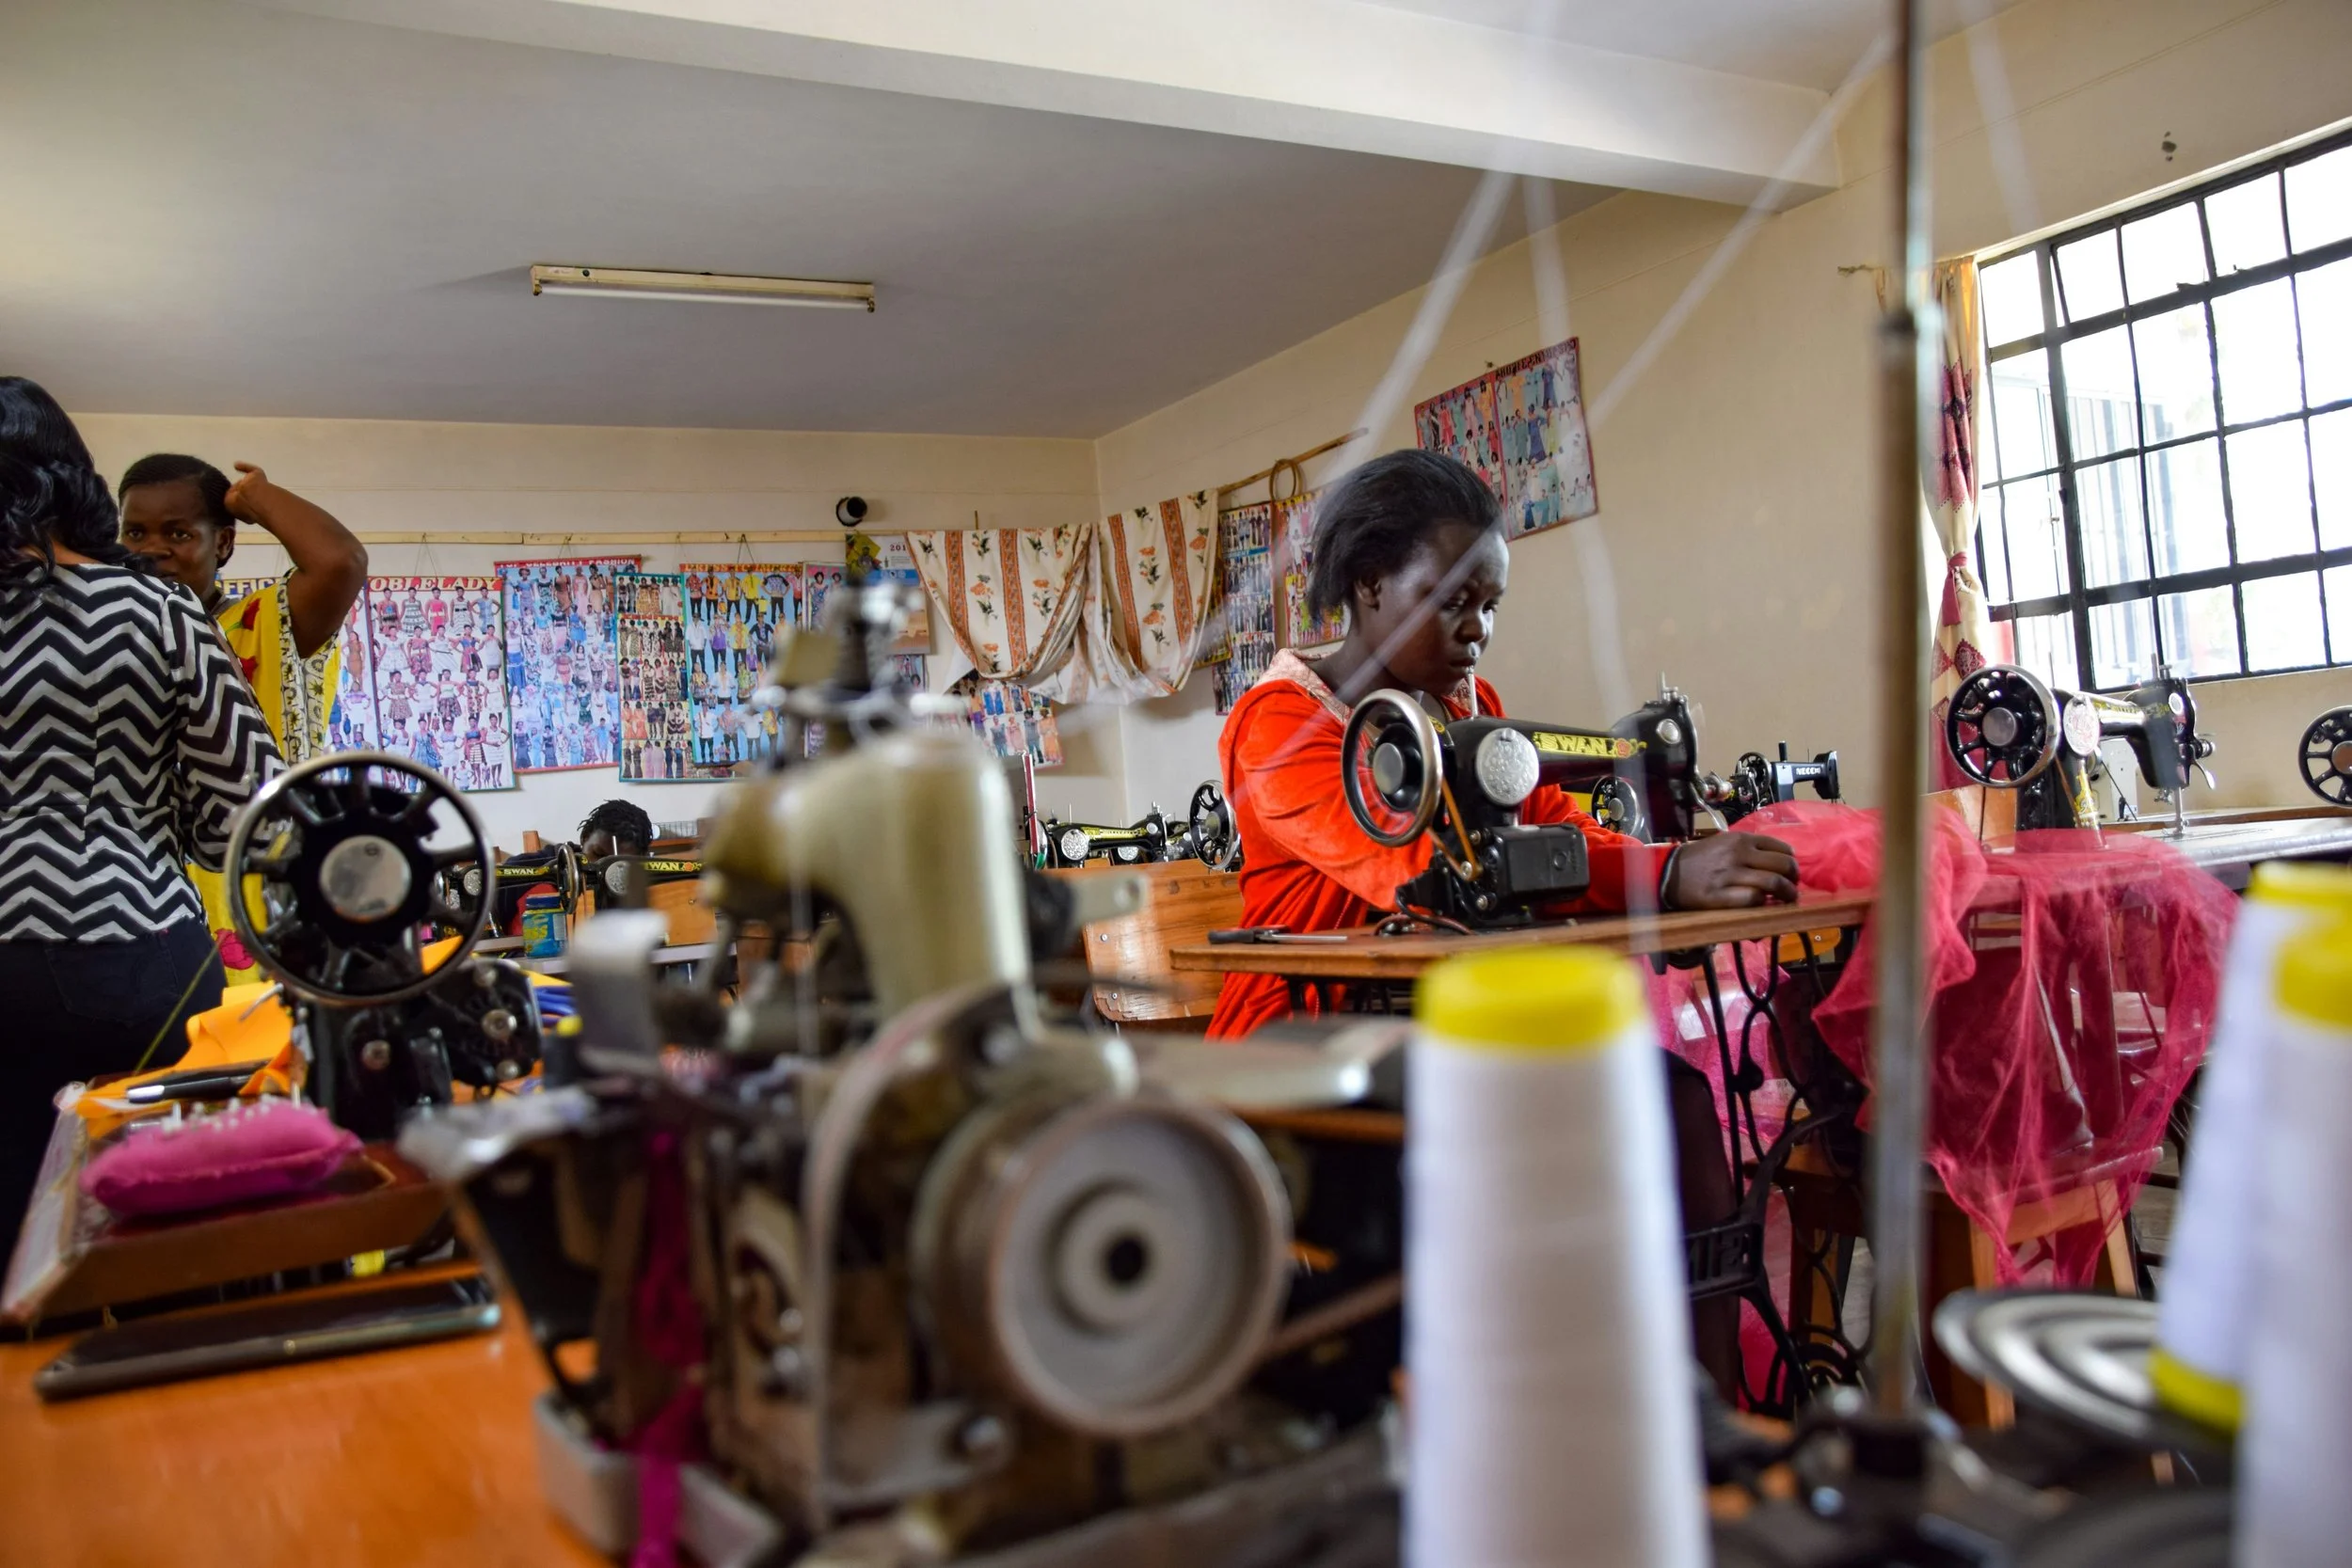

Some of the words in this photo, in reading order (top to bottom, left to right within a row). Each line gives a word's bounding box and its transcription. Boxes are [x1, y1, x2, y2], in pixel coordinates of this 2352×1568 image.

[890, 543, 907, 552] 201
[215, 577, 282, 595] FFIC
[368, 577, 499, 592] OBLELADY
[1540, 733, 1607, 757] SWAN
[644, 862, 678, 871] WAN
